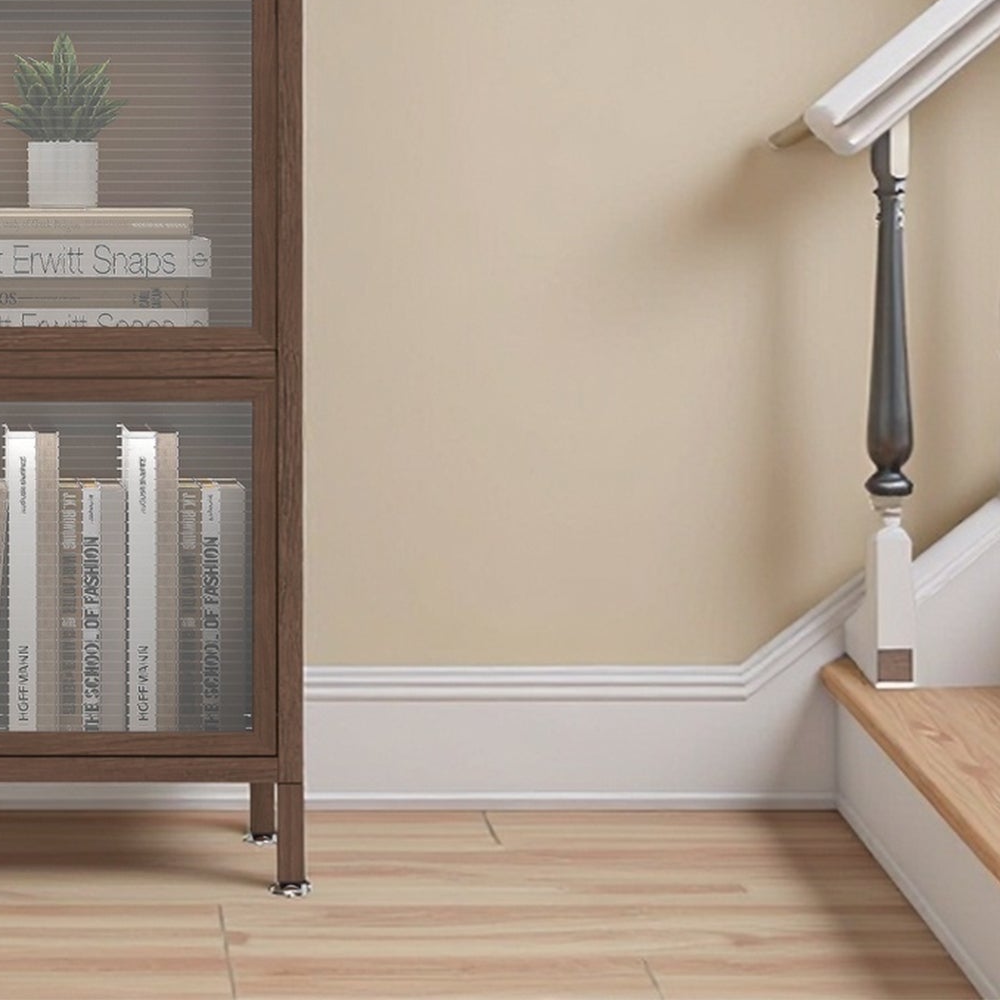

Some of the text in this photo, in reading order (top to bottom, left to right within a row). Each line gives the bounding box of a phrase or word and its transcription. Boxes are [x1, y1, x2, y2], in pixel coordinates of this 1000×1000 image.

[13, 244, 84, 275] Erwitt
[93, 244, 176, 278] Snaps
[84, 536, 100, 608] FASHION
[204, 536, 219, 608] FASHION
[84, 609, 100, 630] OF
[204, 609, 219, 630] OF
[19, 645, 29, 722] HOFFMANN
[84, 632, 100, 701] SCHOOL
[139, 645, 149, 722] HOFFMANN
[204, 632, 219, 701] SCHOOL
